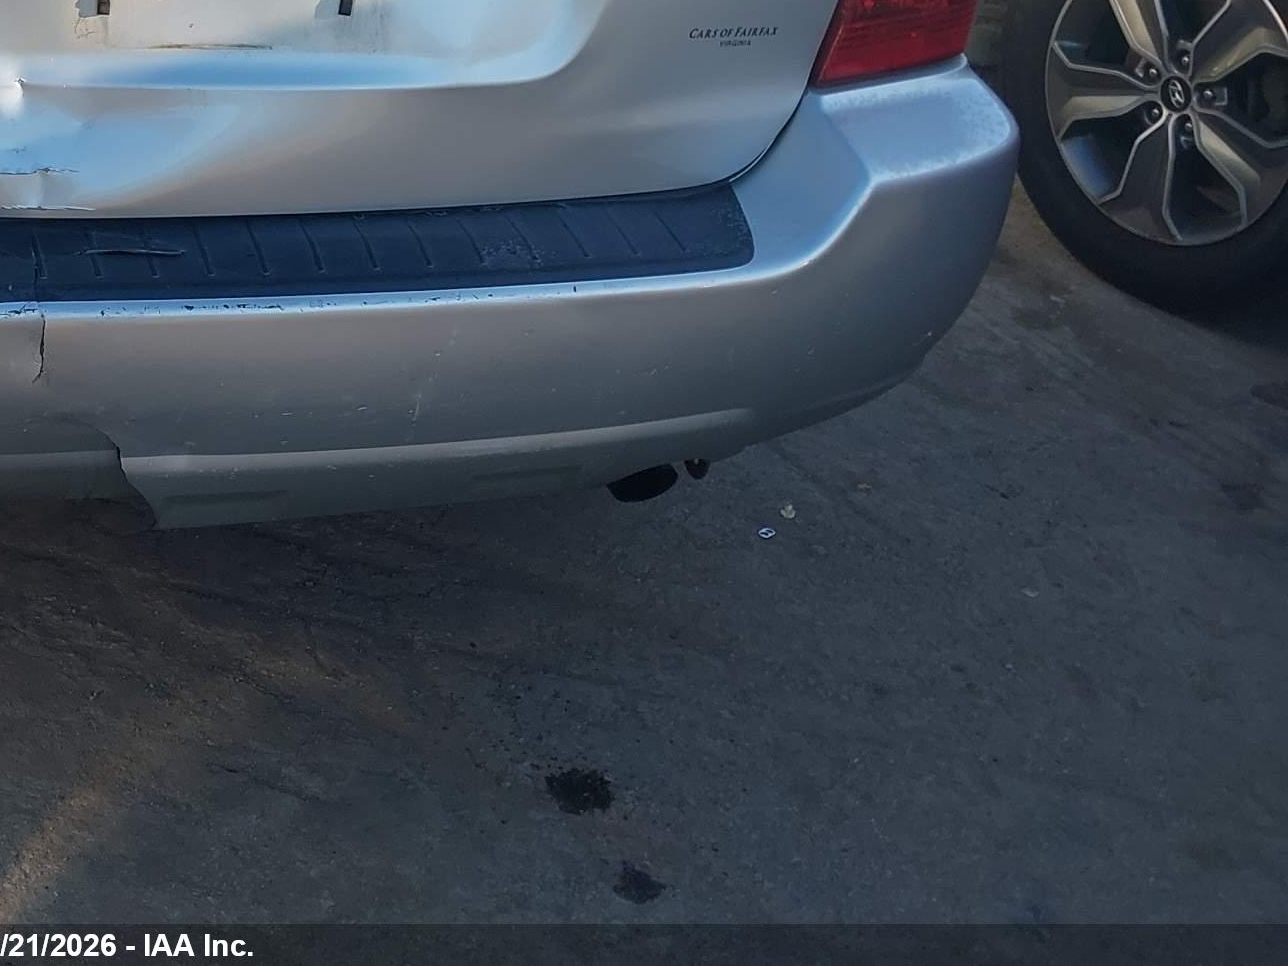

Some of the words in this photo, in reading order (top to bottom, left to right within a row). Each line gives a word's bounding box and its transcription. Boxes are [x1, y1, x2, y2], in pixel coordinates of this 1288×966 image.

[689, 28, 718, 39] CARS
[720, 28, 734, 38] OF
[735, 26, 778, 37] FAIRFAX
